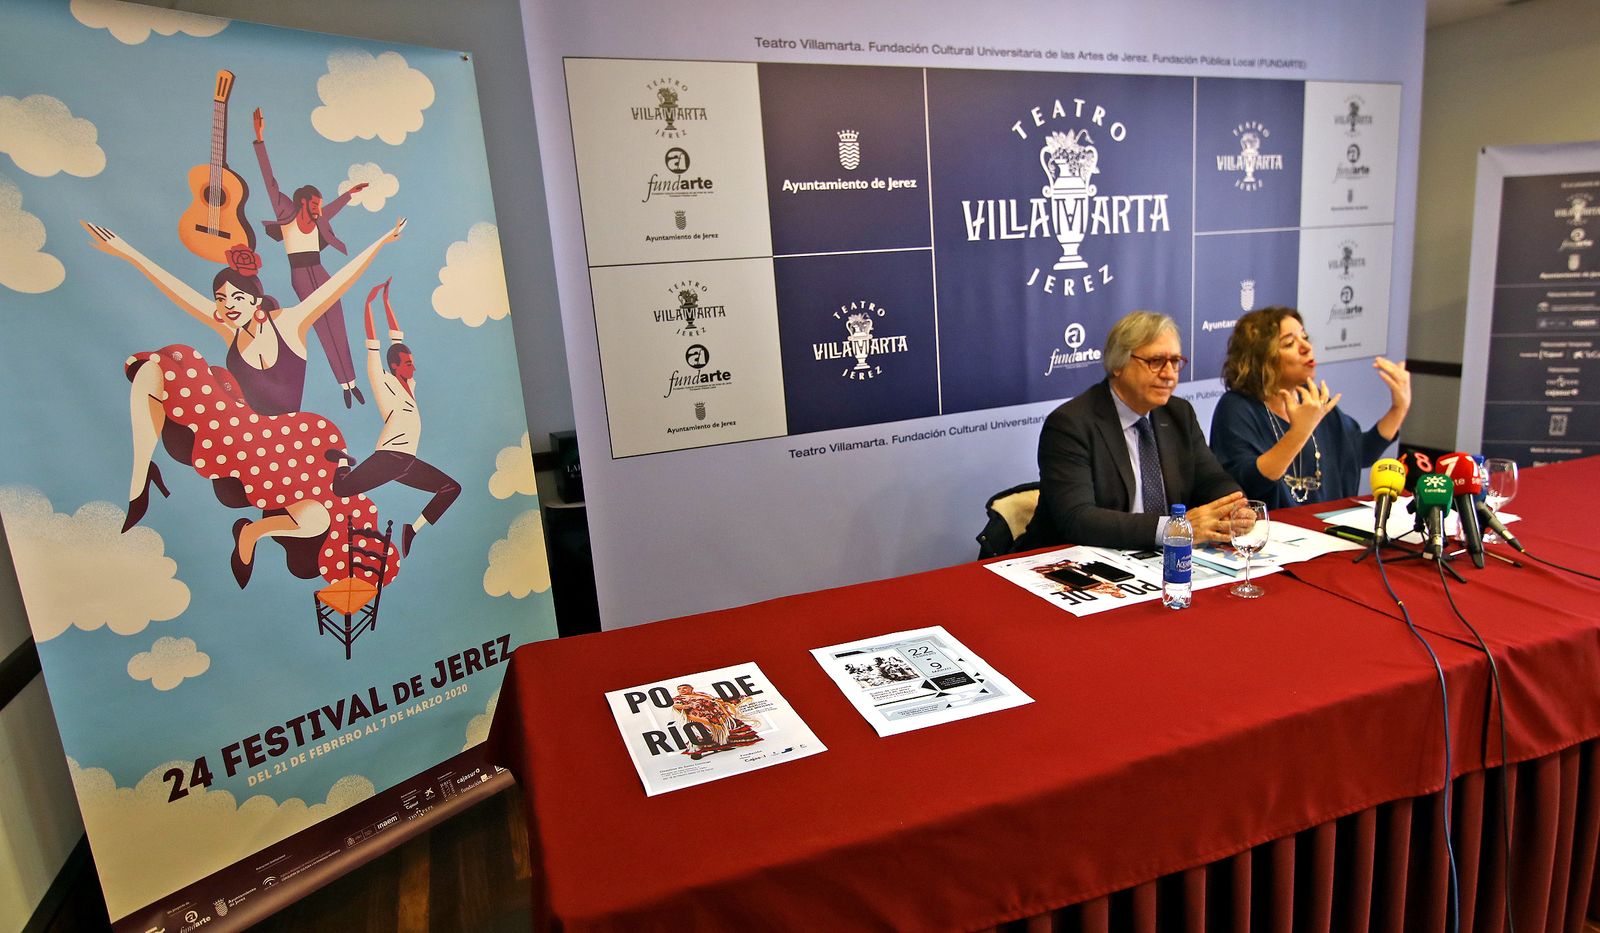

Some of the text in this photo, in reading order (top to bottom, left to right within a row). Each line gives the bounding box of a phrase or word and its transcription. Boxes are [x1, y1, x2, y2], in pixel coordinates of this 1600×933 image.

[754, 37, 797, 50] Teatro
[799, 39, 864, 52] Villamarta.
[868, 41, 929, 54] Fundación
[932, 44, 974, 56] Cultural
[977, 47, 1042, 59] Universitaria
[1045, 49, 1058, 60] de
[1061, 50, 1075, 60] las
[1078, 51, 1104, 61] Artes
[1107, 52, 1119, 62] de
[646, 78, 688, 92] TEATRO
[631, 107, 708, 121] VILLAMARTA
[1011, 98, 1127, 142] TEATRO
[655, 129, 687, 139] JEREZ
[642, 174, 713, 203] fundarte
[782, 177, 917, 194] Ayuntamiento de Jerez
[962, 194, 1170, 241] VILLAMARTA
[645, 232, 692, 242] Ayuntamiento
[703, 232, 719, 241] Jerez
[668, 280, 708, 294] TEATRO
[1027, 264, 1114, 297] JEREZ
[653, 306, 726, 322] VILLAMARTA
[833, 300, 885, 320] TEATRO
[676, 327, 707, 337] JEREZ
[813, 335, 908, 360] VILLAMARTA
[842, 366, 882, 380] JEREZ
[1045, 348, 1101, 376] fundarte
[664, 370, 732, 398] fundarte
[667, 423, 711, 434] Ayuntamiento
[721, 420, 736, 429] Jerez
[789, 414, 1047, 459] Teatro Villamarta. Fundación Cultural Universitari
[908, 646, 933, 656] 22
[623, 674, 764, 715] PO DE
[162, 633, 511, 802] 24 FESTIVAL DE JEREZ
[247, 683, 469, 788] DEL 21 DE FEBRERO AL 7 DE MARZO 2020
[642, 720, 712, 757] RÍO
